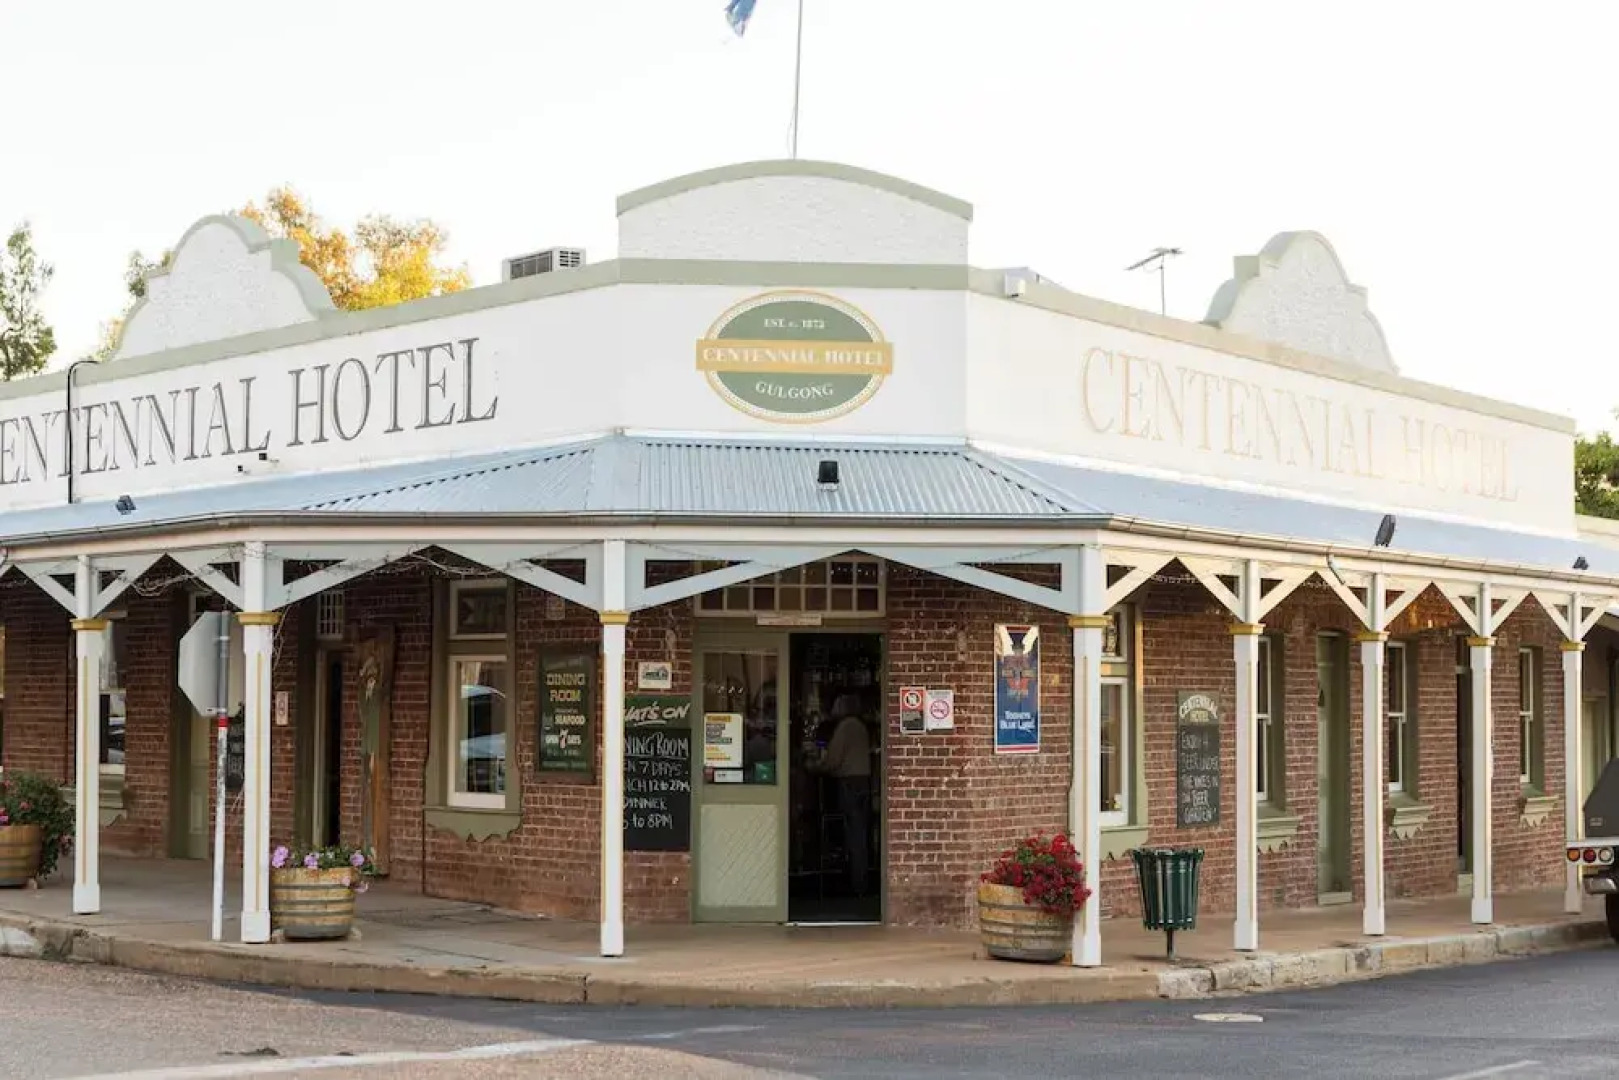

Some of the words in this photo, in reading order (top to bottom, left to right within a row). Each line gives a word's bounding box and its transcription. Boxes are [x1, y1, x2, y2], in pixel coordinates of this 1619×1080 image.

[703, 347, 819, 365] CENTENNIAL
[824, 349, 885, 366] HOTEL
[755, 380, 834, 400] GULGONG
[0, 376, 271, 485] ENTENNIAL
[286, 337, 498, 447] HOTEL
[1081, 346, 1386, 479] CENTENNIAL
[1398, 414, 1519, 502] HOTEL
[545, 673, 586, 686] DINING
[549, 689, 581, 702] ROOM
[661, 703, 691, 719] ON
[624, 734, 655, 756] NING
[639, 760, 650, 774] 7
[648, 813, 673, 830] 8PM
